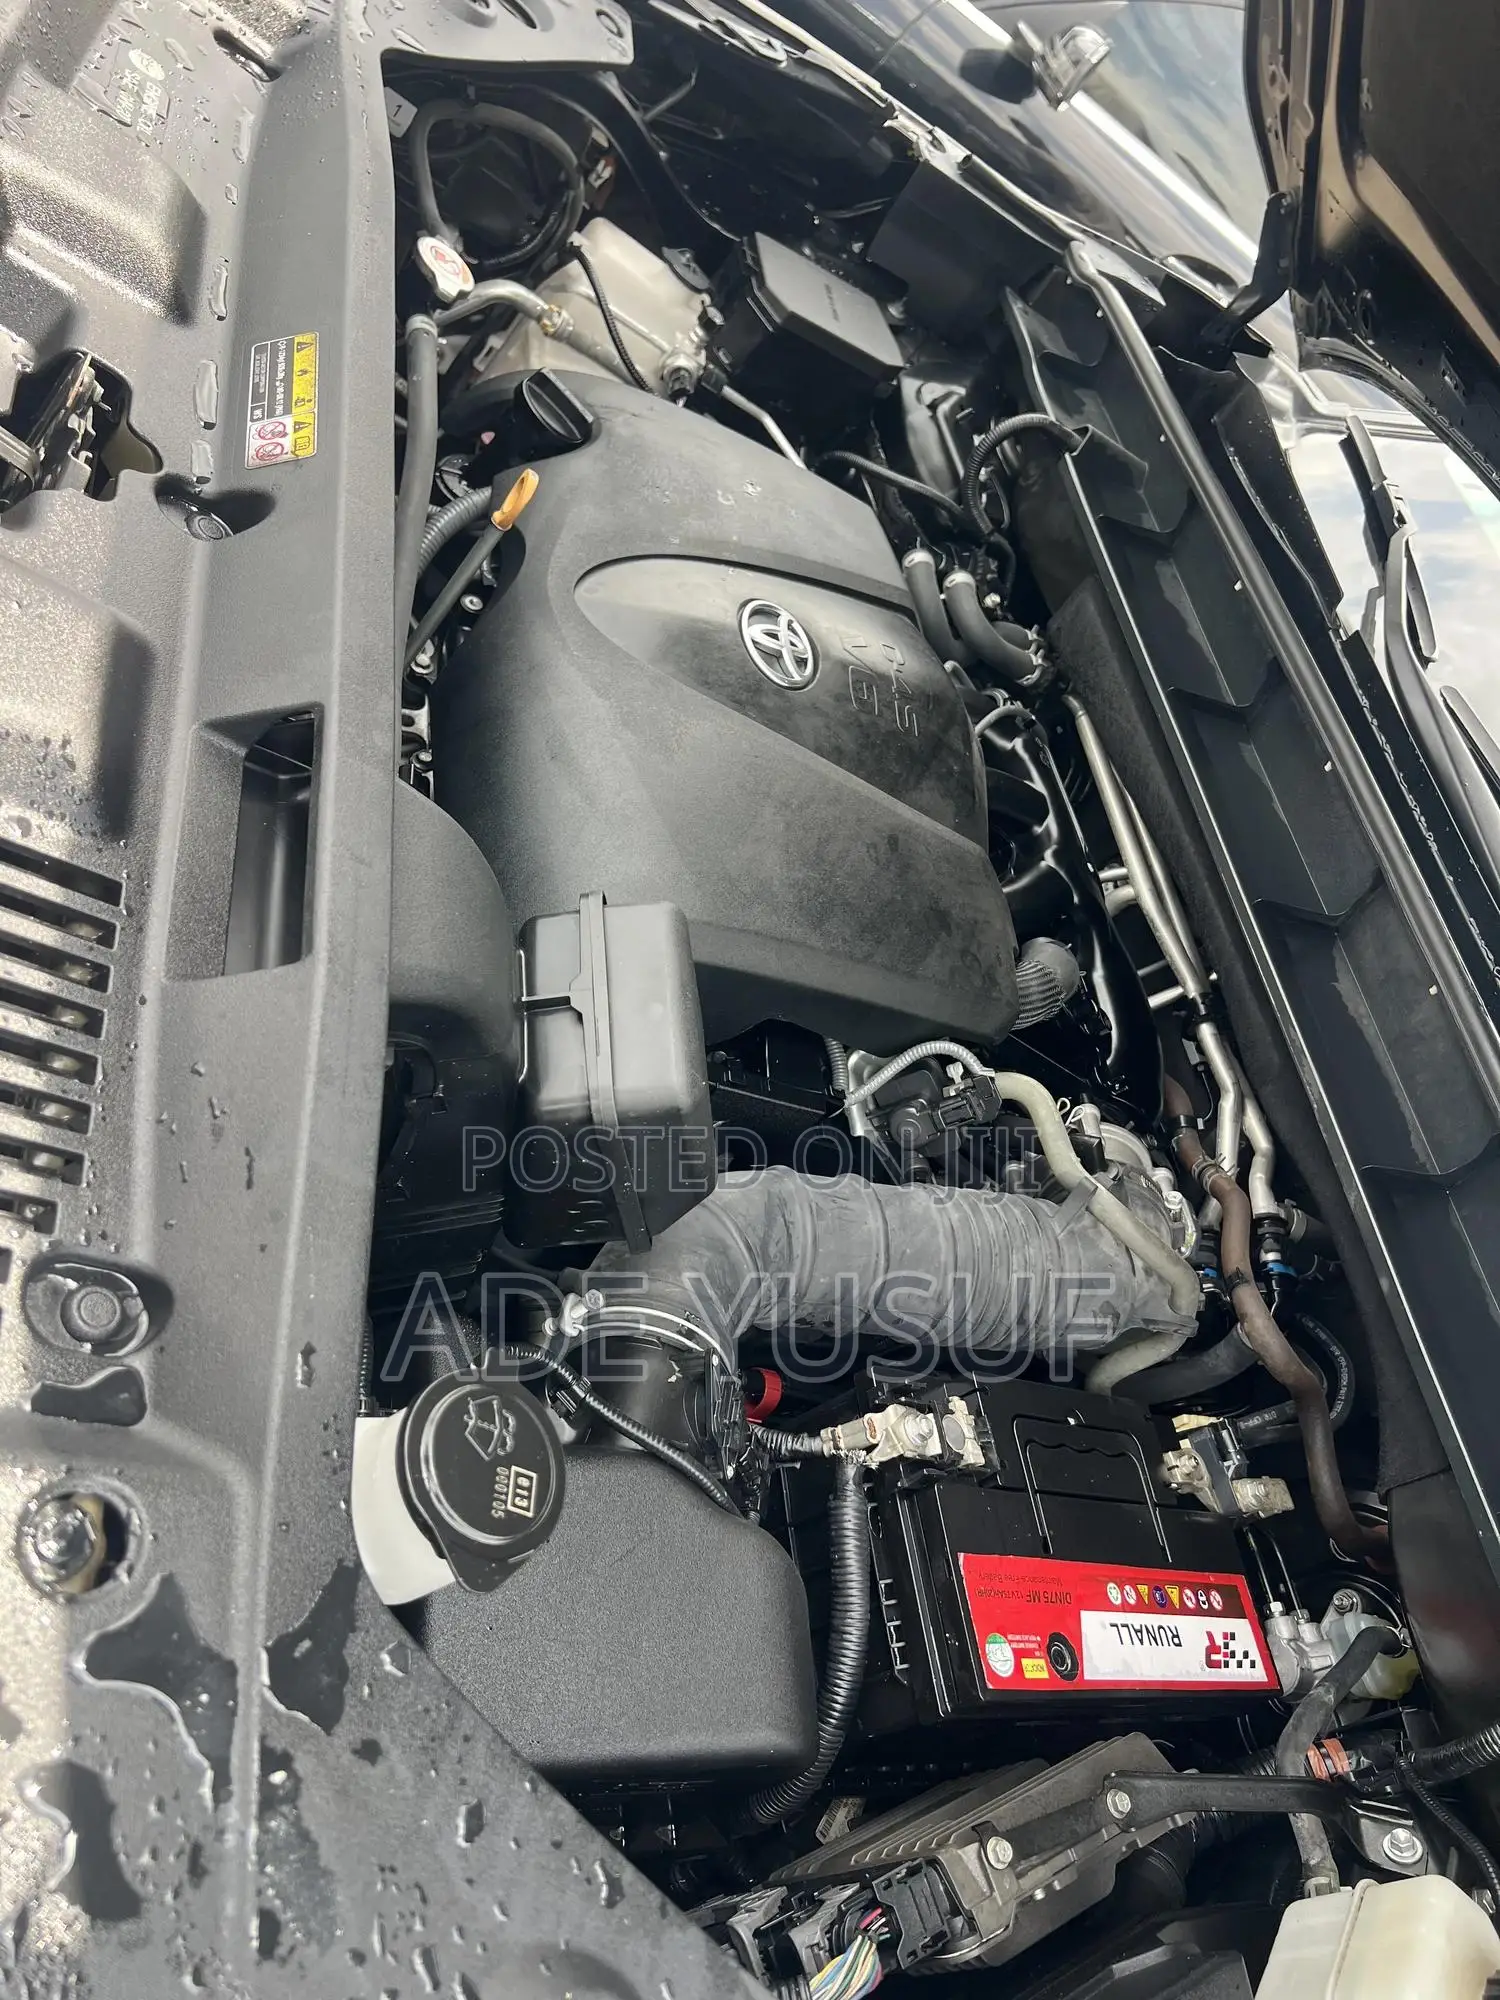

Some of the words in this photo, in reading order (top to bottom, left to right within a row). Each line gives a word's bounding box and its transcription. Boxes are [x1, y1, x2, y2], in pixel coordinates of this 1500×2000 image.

[1026, 1589, 1041, 1603] MF
[1043, 1590, 1073, 1605] DIN75
[1109, 1622, 1183, 1648] RUNALL
